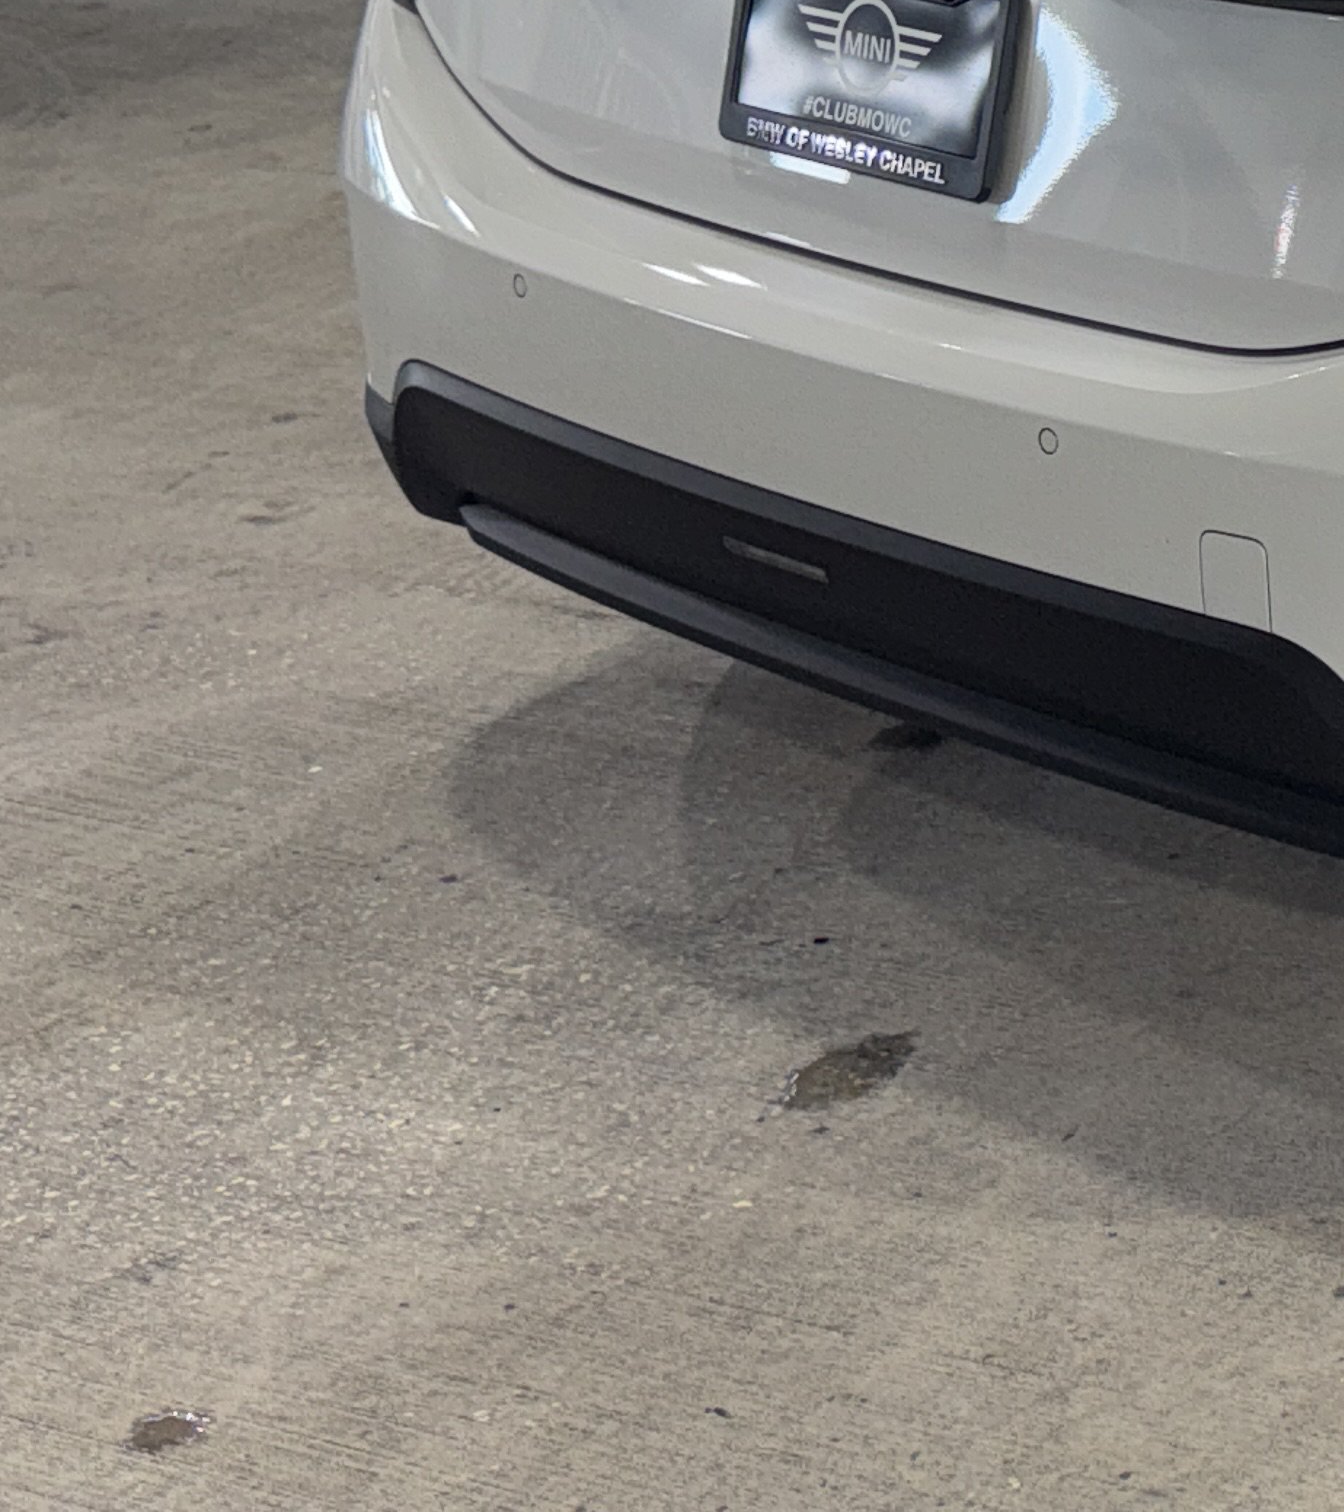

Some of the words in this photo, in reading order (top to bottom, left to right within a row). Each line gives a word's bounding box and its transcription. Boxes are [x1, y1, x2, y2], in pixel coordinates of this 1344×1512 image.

[842, 29, 892, 64] MINI
[802, 95, 912, 138] #CLUBMOWC
[786, 126, 809, 151] OF
[810, 132, 878, 168] WESLEY
[879, 150, 946, 185] CHAPEL
